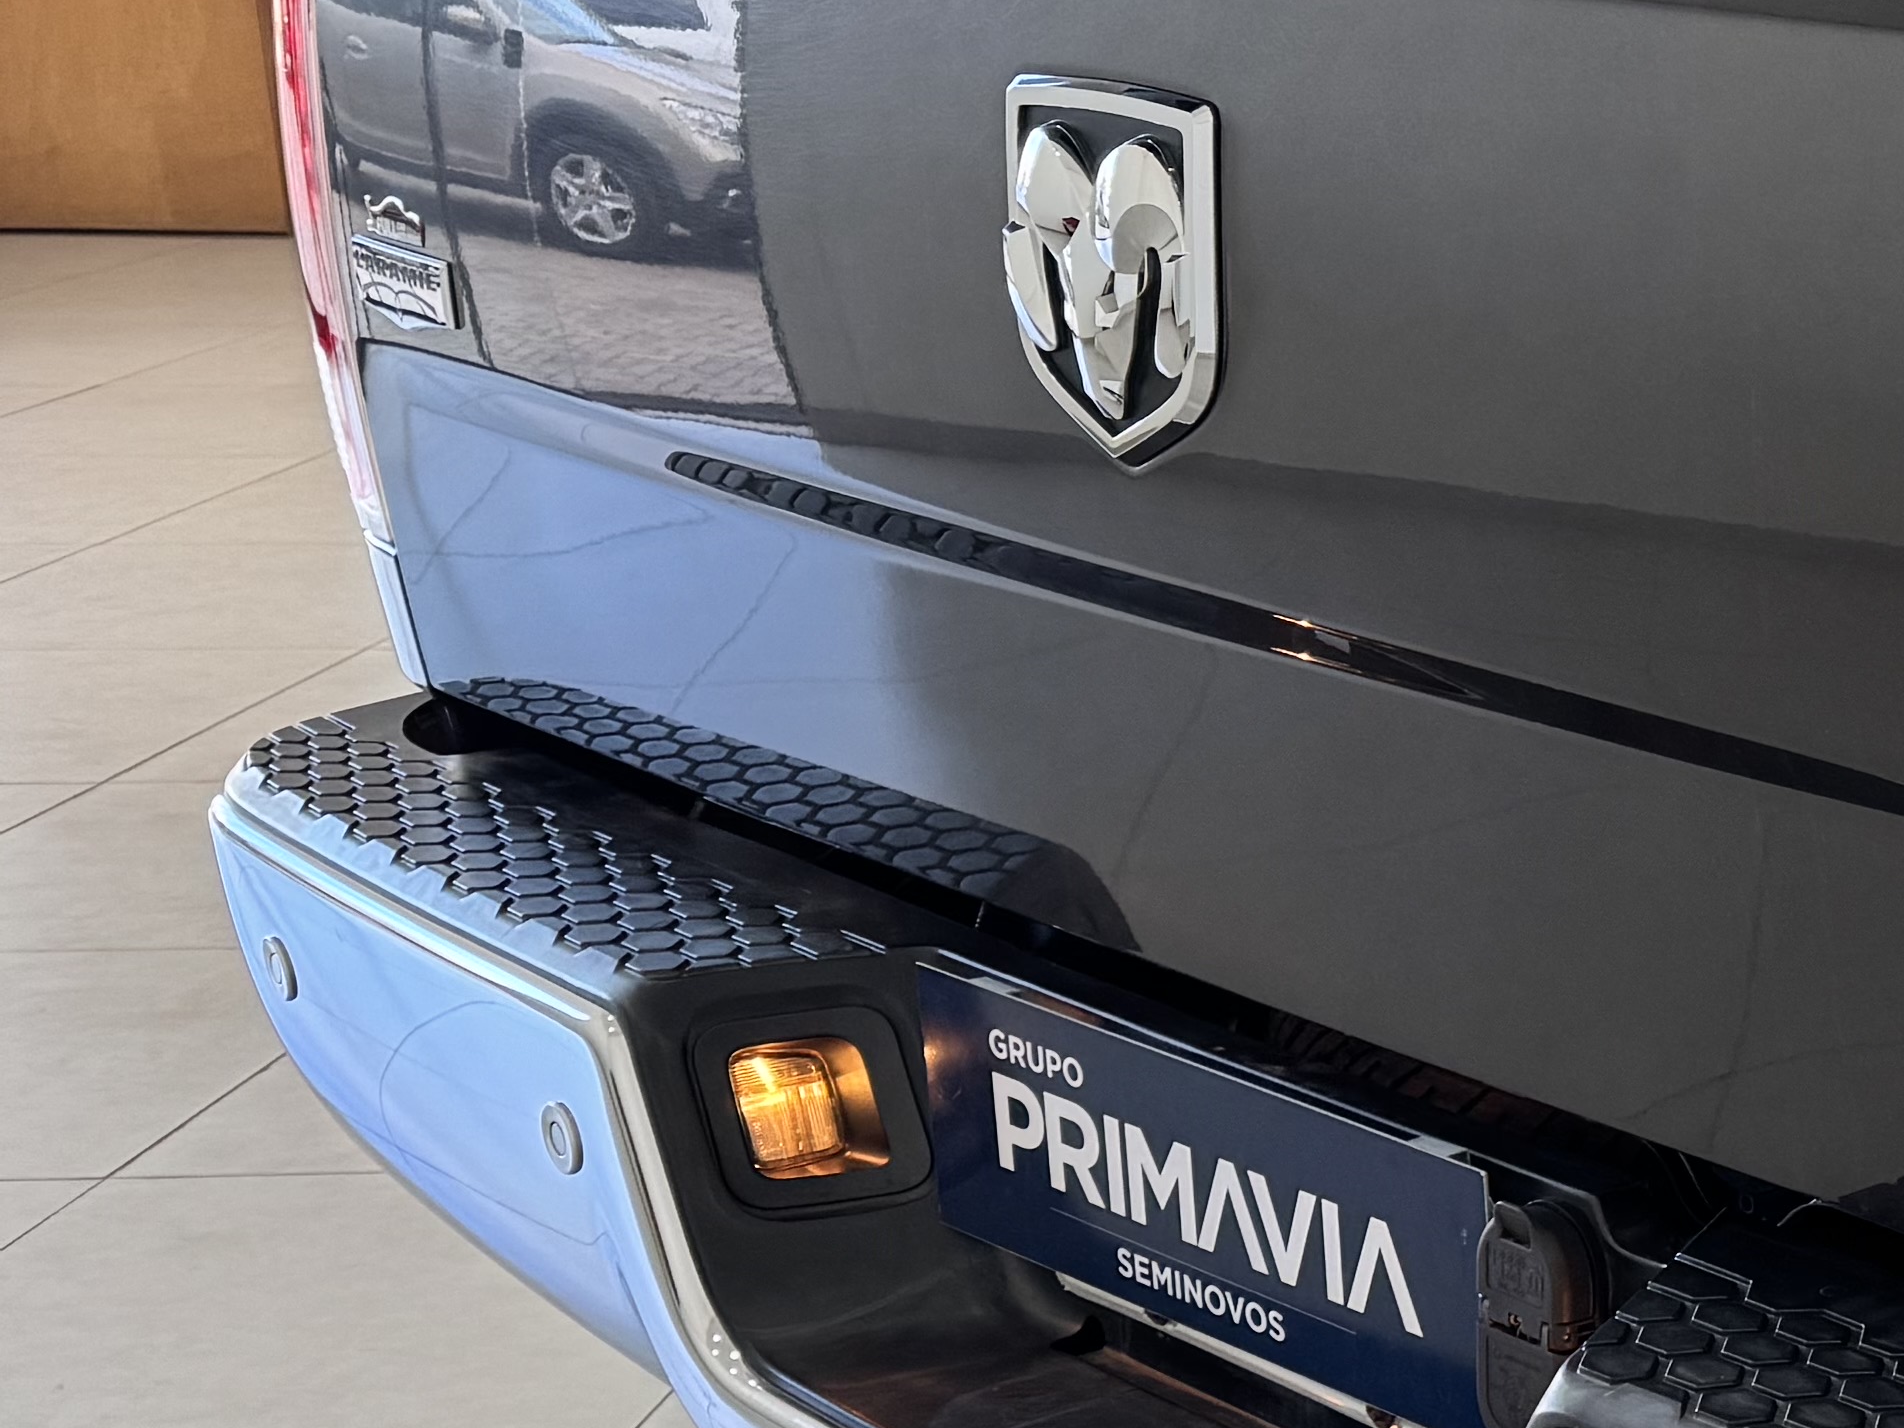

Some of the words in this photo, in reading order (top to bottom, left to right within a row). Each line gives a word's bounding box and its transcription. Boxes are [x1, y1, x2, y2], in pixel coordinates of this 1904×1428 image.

[353, 247, 441, 292] LARAMIE
[987, 1028, 1084, 1088] GRUPO
[991, 1071, 1424, 1338] PRIMAVIA
[1116, 1246, 1287, 1343] SEMINOVOS
